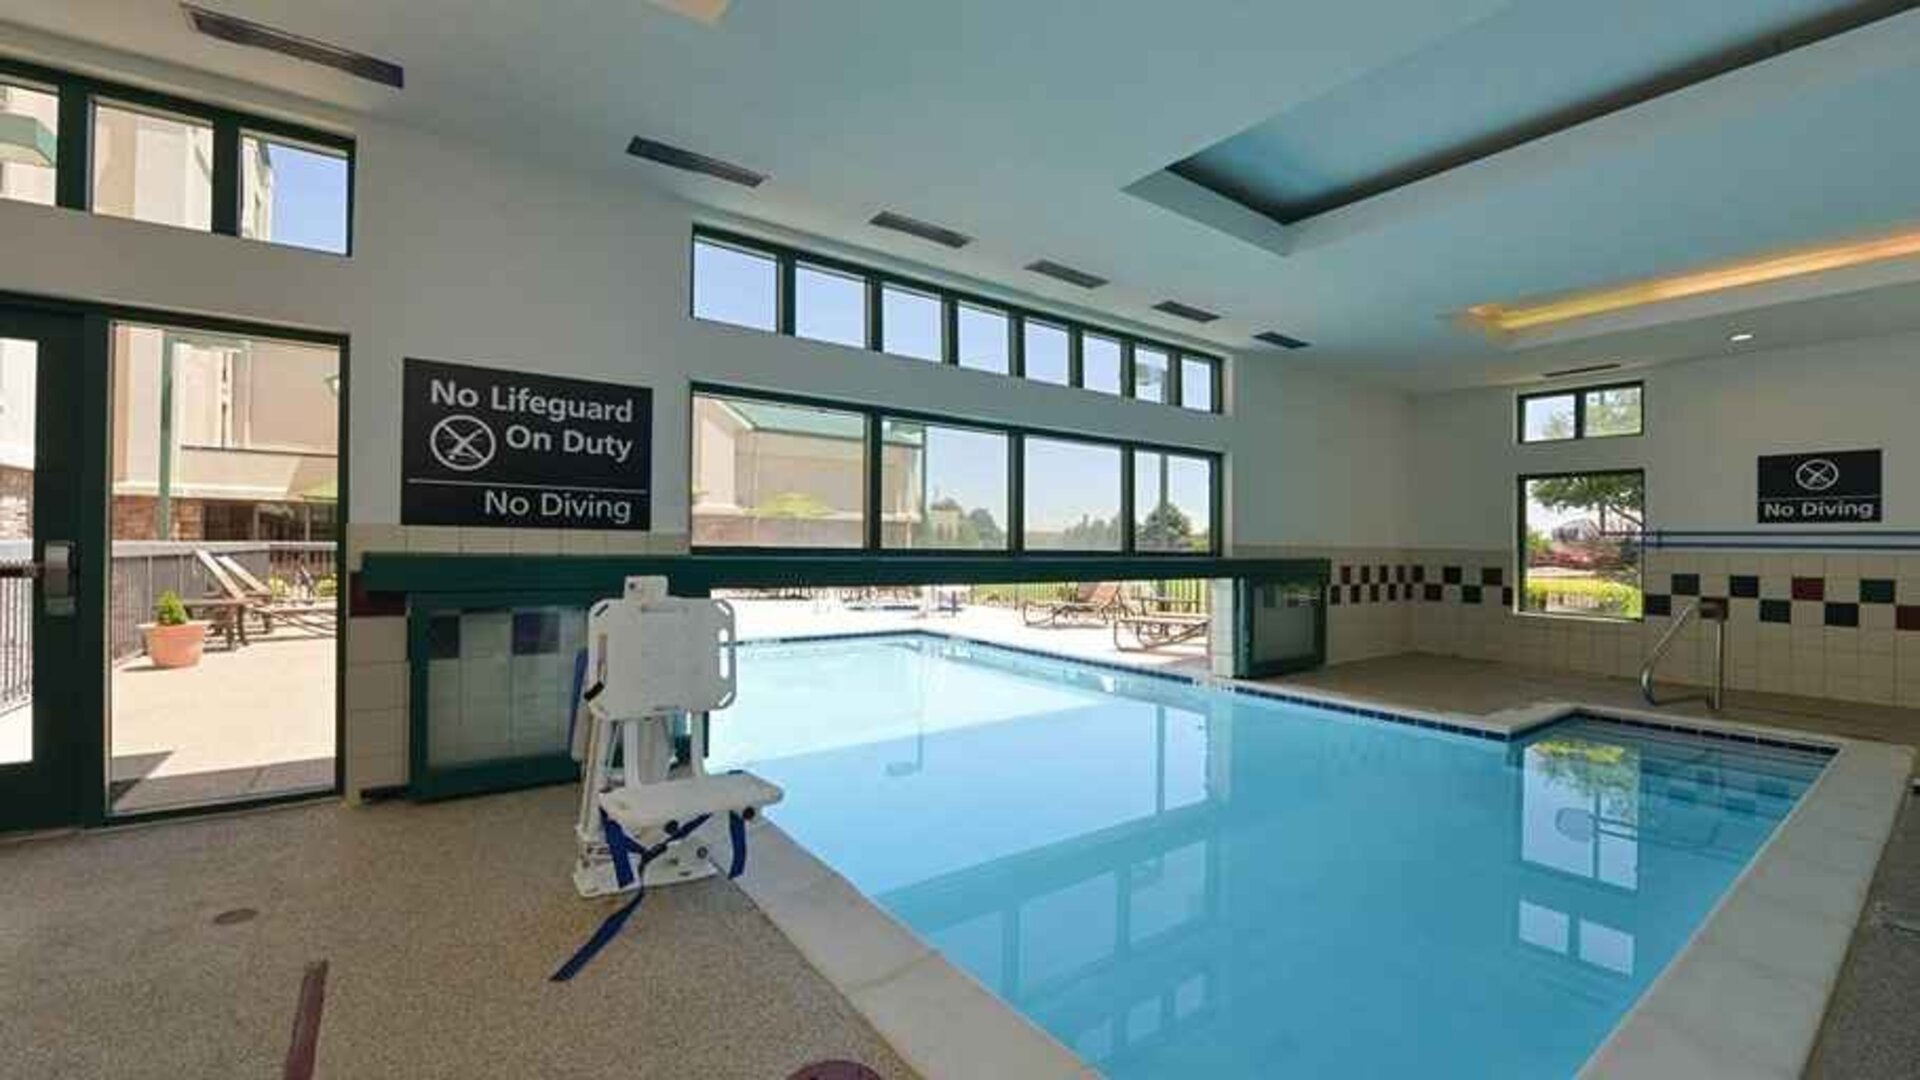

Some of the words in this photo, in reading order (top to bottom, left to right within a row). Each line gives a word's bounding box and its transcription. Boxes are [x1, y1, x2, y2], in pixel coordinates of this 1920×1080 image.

[430, 379, 479, 406] No
[491, 386, 633, 423] Lifeguard
[505, 424, 551, 451] On
[563, 430, 633, 463] Duty
[484, 491, 530, 516] No
[541, 493, 631, 524] Diving
[1765, 503, 1794, 517] No
[1801, 500, 1874, 518] Diving
